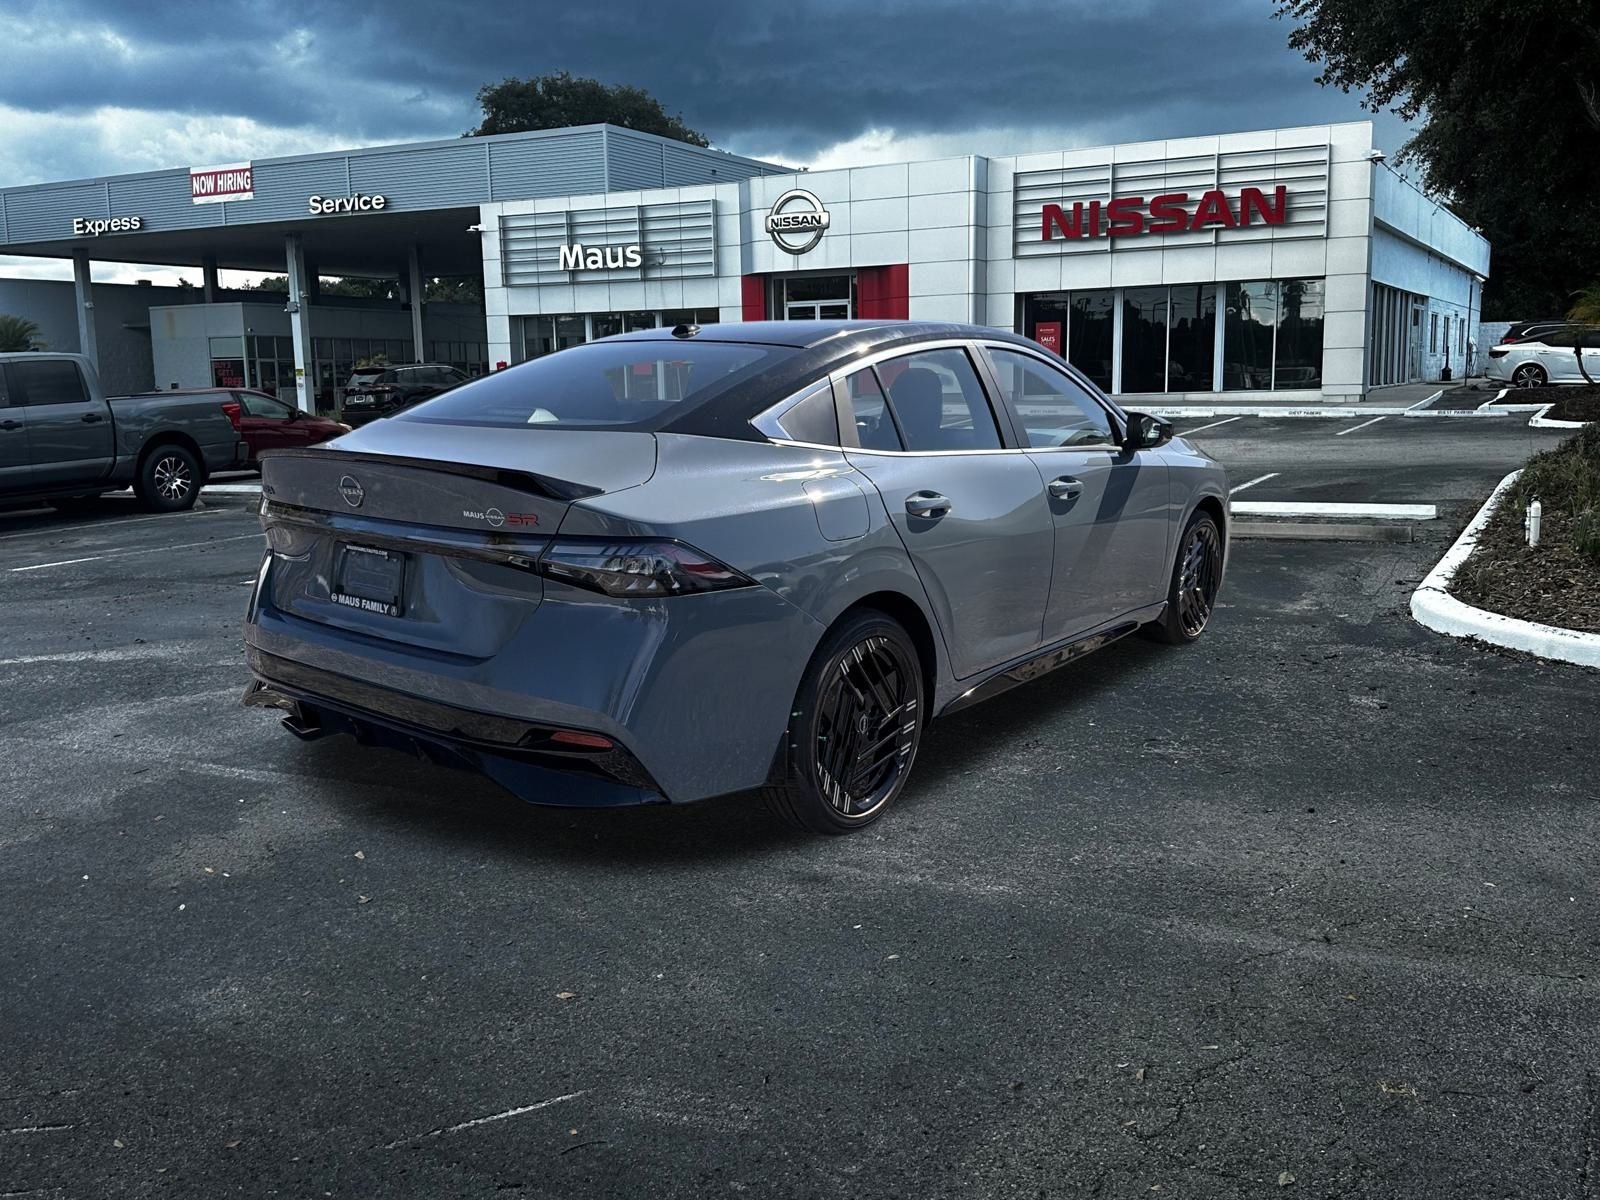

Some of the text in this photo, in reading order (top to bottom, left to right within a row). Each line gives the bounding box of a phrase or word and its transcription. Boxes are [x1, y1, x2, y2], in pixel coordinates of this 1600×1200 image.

[192, 171, 251, 195] NOW HIRING
[309, 193, 385, 214] Service
[1041, 185, 1287, 241] NISSAN
[73, 217, 141, 236] Express
[770, 215, 822, 228] NISSAN
[560, 243, 642, 270] Maus
[463, 510, 485, 520] MAUS
[507, 512, 539, 527] SR
[338, 594, 390, 614] MAUS FAMILY
